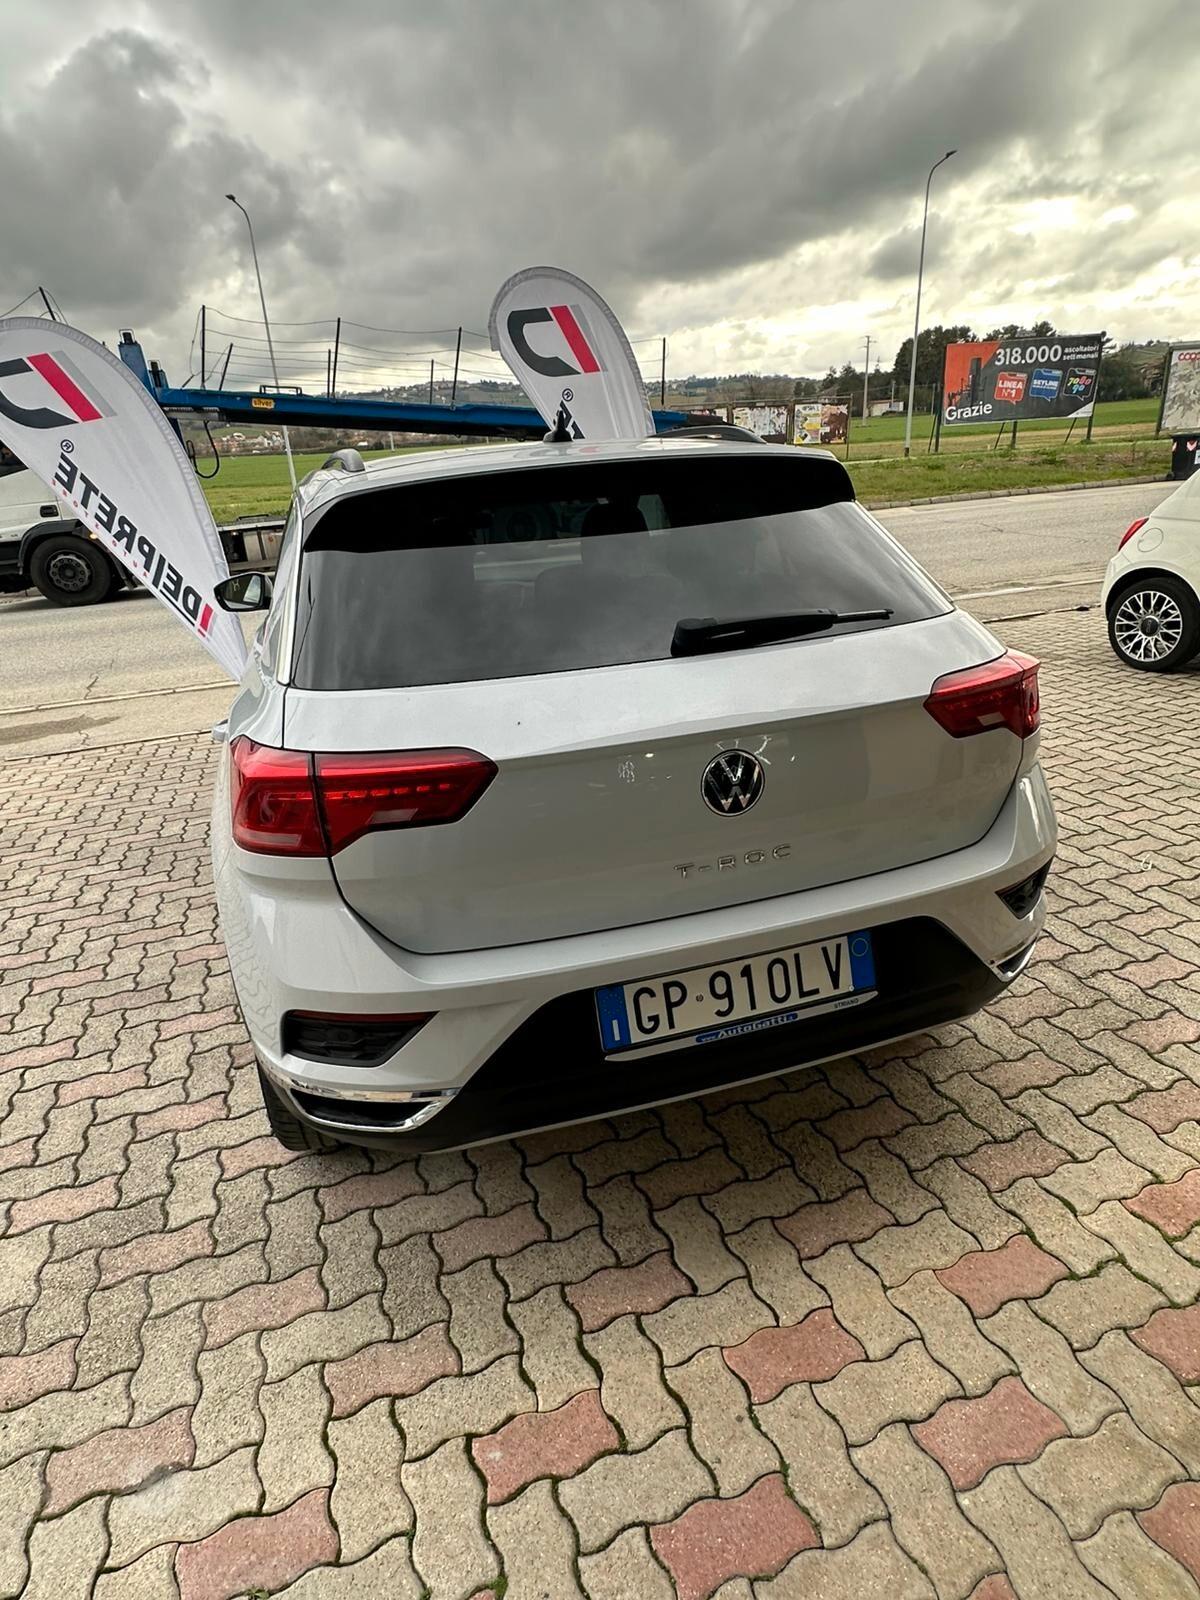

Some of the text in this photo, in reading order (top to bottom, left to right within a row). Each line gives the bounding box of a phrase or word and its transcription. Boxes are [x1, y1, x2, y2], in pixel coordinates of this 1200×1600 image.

[994, 344, 1062, 366] 318.000
[1062, 352, 1099, 361] settimanali
[1064, 344, 1099, 353] ascoltatori
[998, 380, 1023, 389] LINEA
[945, 401, 993, 420] Grazie
[673, 843, 791, 879] T-ROC
[632, 980, 688, 1035] GP
[708, 943, 842, 1018] 910LV
